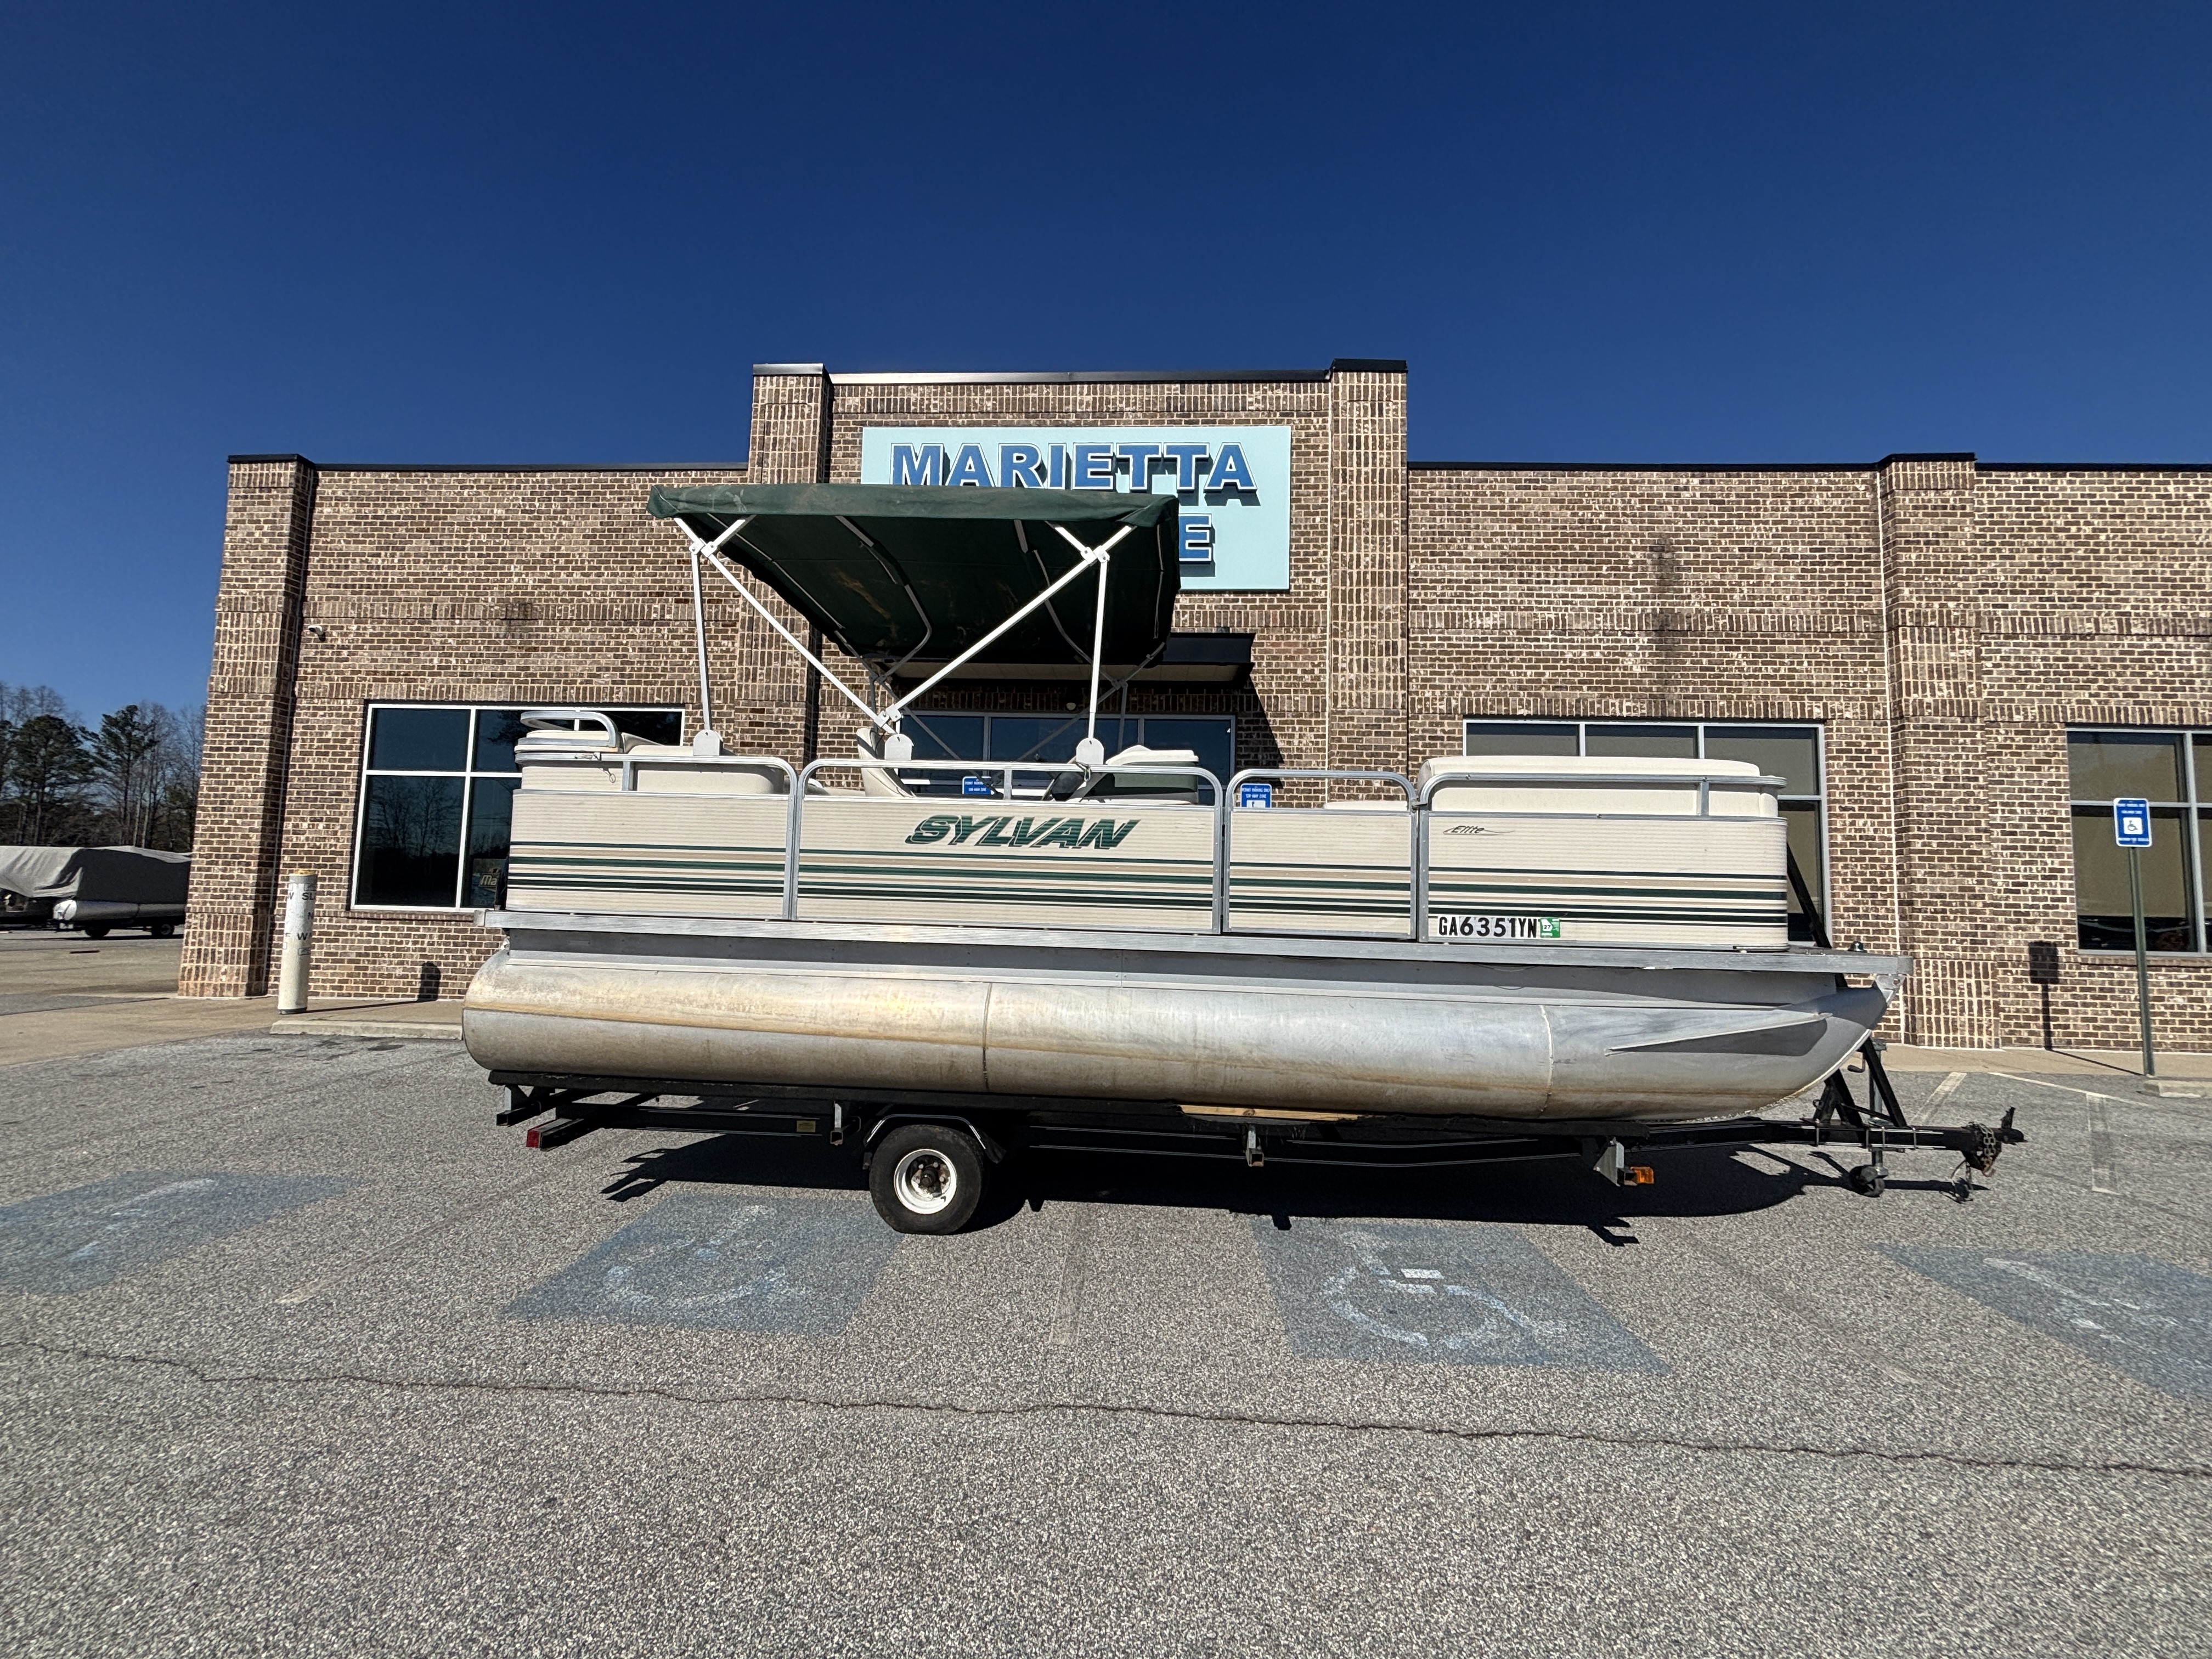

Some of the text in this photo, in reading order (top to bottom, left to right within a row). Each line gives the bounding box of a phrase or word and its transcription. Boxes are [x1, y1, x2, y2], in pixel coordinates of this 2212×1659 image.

[889, 442, 1257, 490] MARIETTA
[904, 814, 1142, 850] SYLVAN
[1451, 825, 1485, 833] Elite
